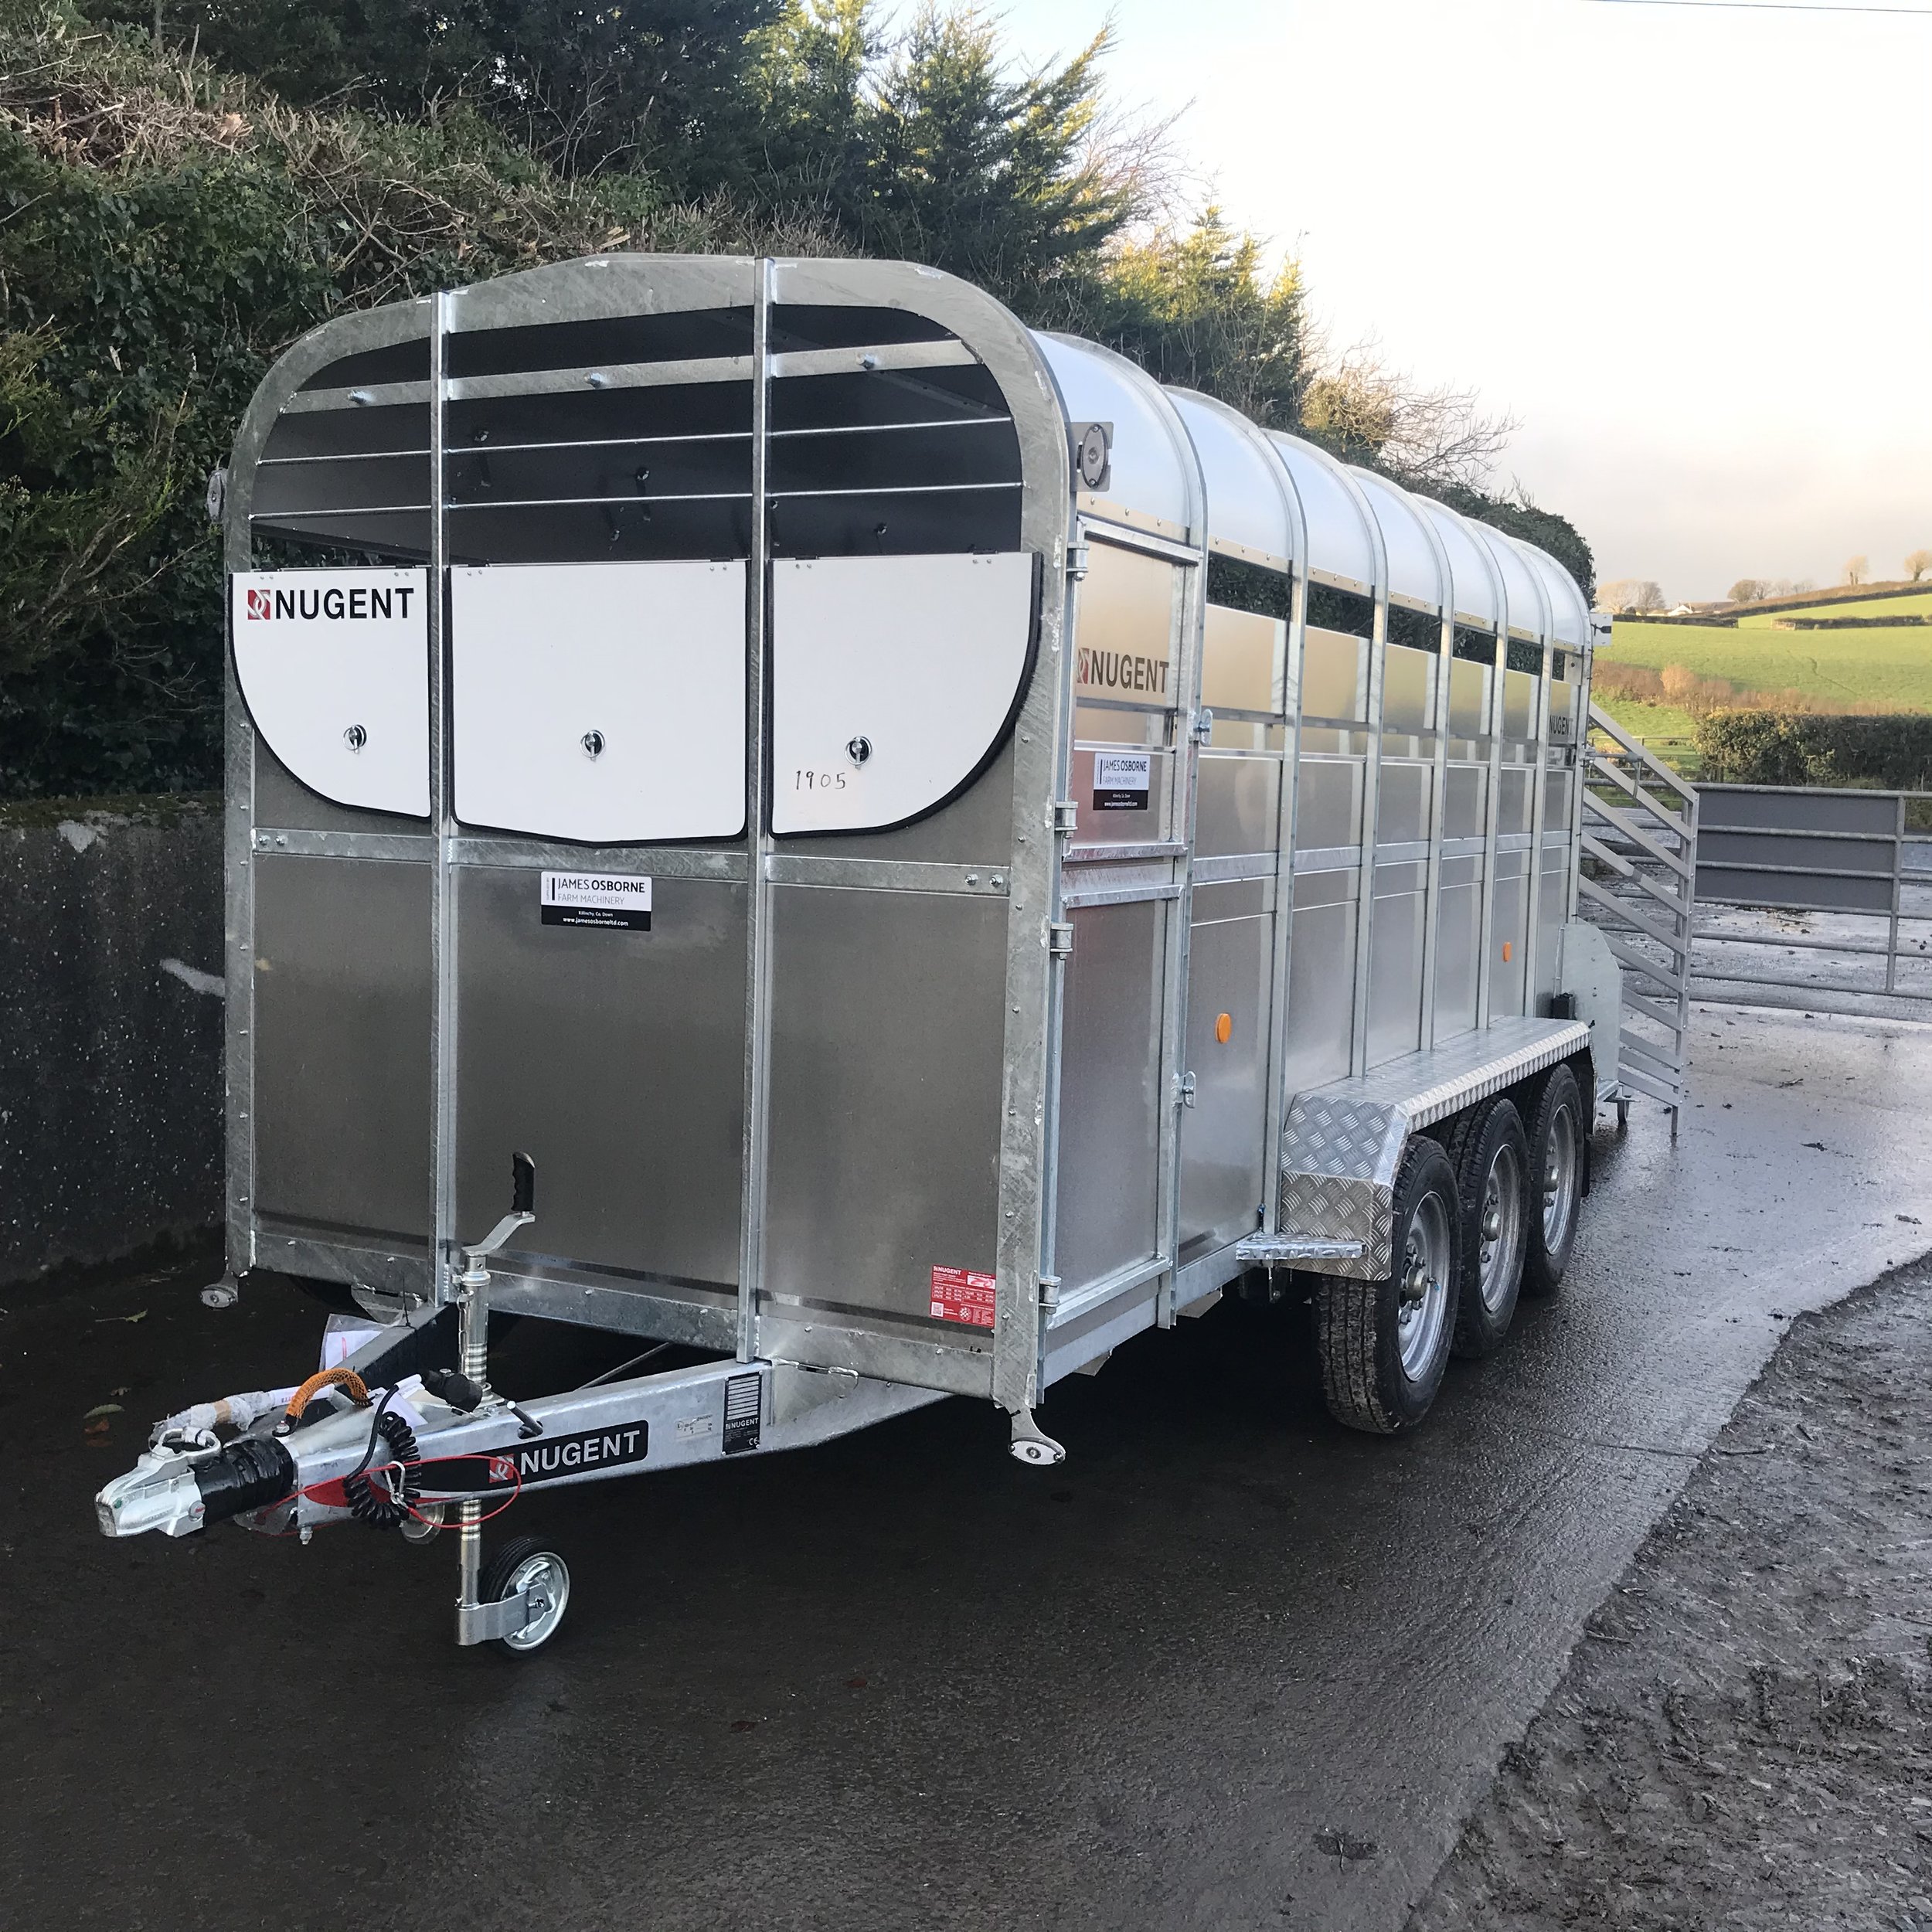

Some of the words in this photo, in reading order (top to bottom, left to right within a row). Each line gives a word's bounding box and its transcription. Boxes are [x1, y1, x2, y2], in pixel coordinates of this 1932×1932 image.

[275, 587, 414, 620] NUGENT
[1090, 650, 1169, 693] NUGENT
[1103, 760, 1121, 771] JAMES
[1121, 760, 1147, 772] OSBORNE
[796, 770, 845, 790] 1905
[557, 878, 590, 889] JAMES
[591, 880, 645, 893] OSBORNE
[557, 893, 579, 903] FARM
[580, 895, 624, 905] MACHINERY
[730, 1417, 759, 1430] NUGENT
[520, 1430, 641, 1475] NUGENT
